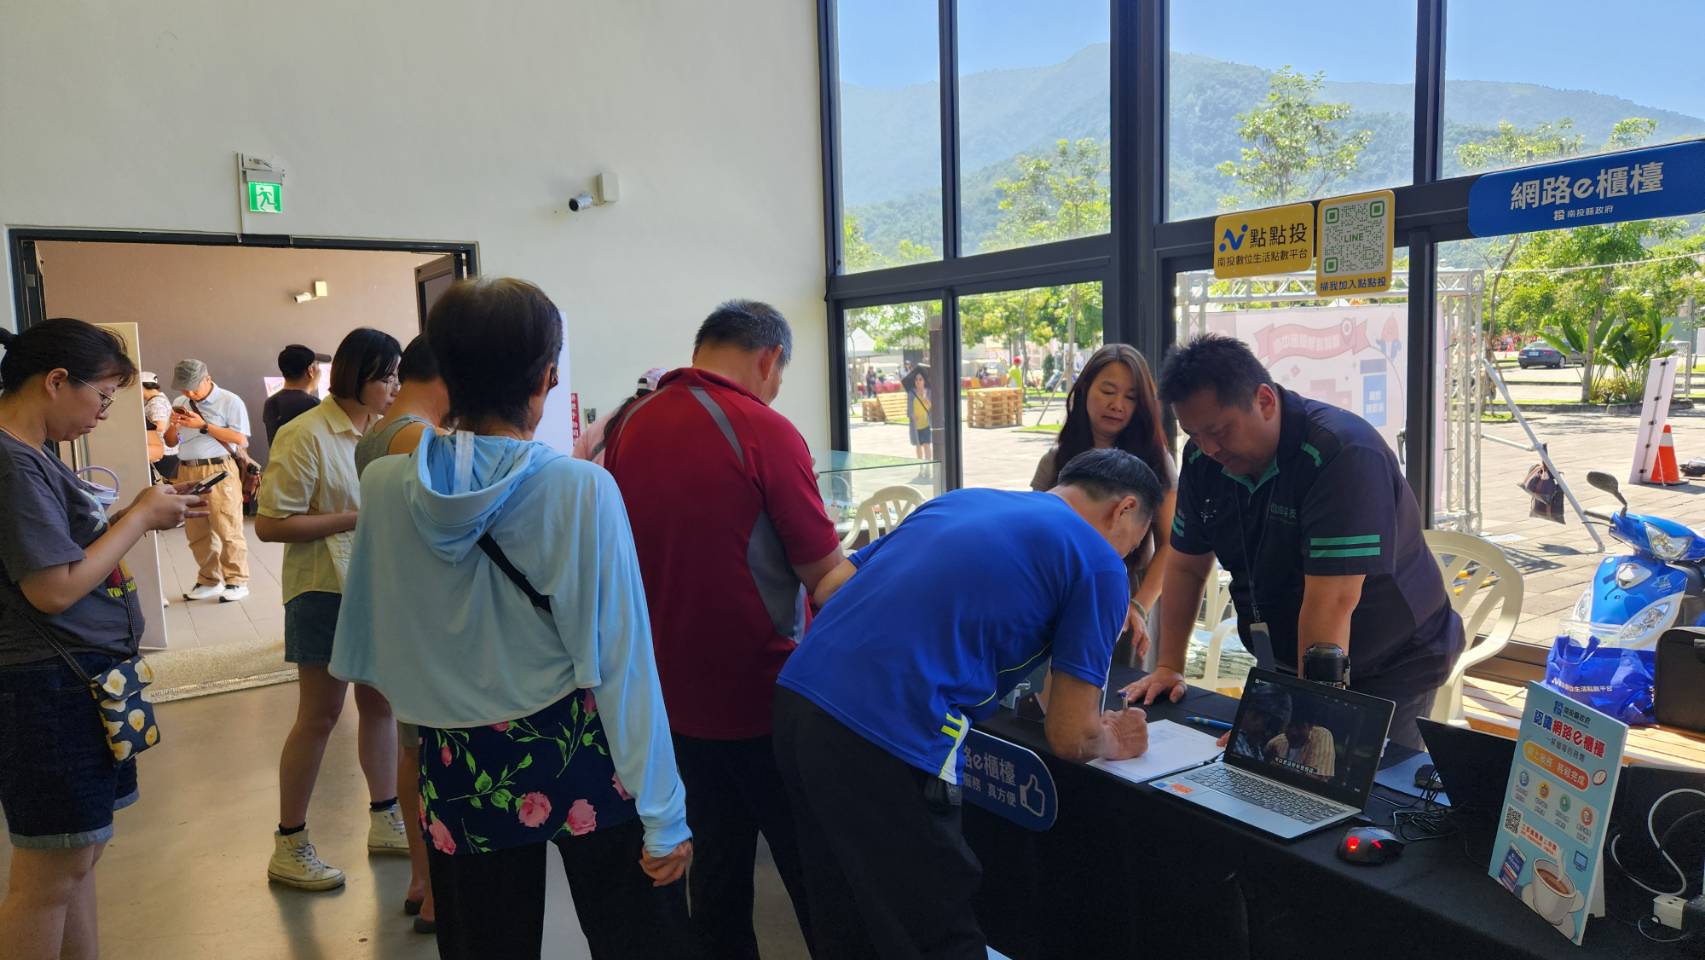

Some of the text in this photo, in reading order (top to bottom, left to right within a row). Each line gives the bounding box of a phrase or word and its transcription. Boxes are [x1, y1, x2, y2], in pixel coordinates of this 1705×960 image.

[1510, 161, 1664, 210] 網路e櫃檯
[1567, 204, 1614, 218] 南投縣政府
[1250, 222, 1308, 249] 點點投
[1344, 232, 1364, 243] LINE
[1217, 249, 1308, 268] 南投數位生活點數平台
[1320, 276, 1386, 292] 掃我加入點點投
